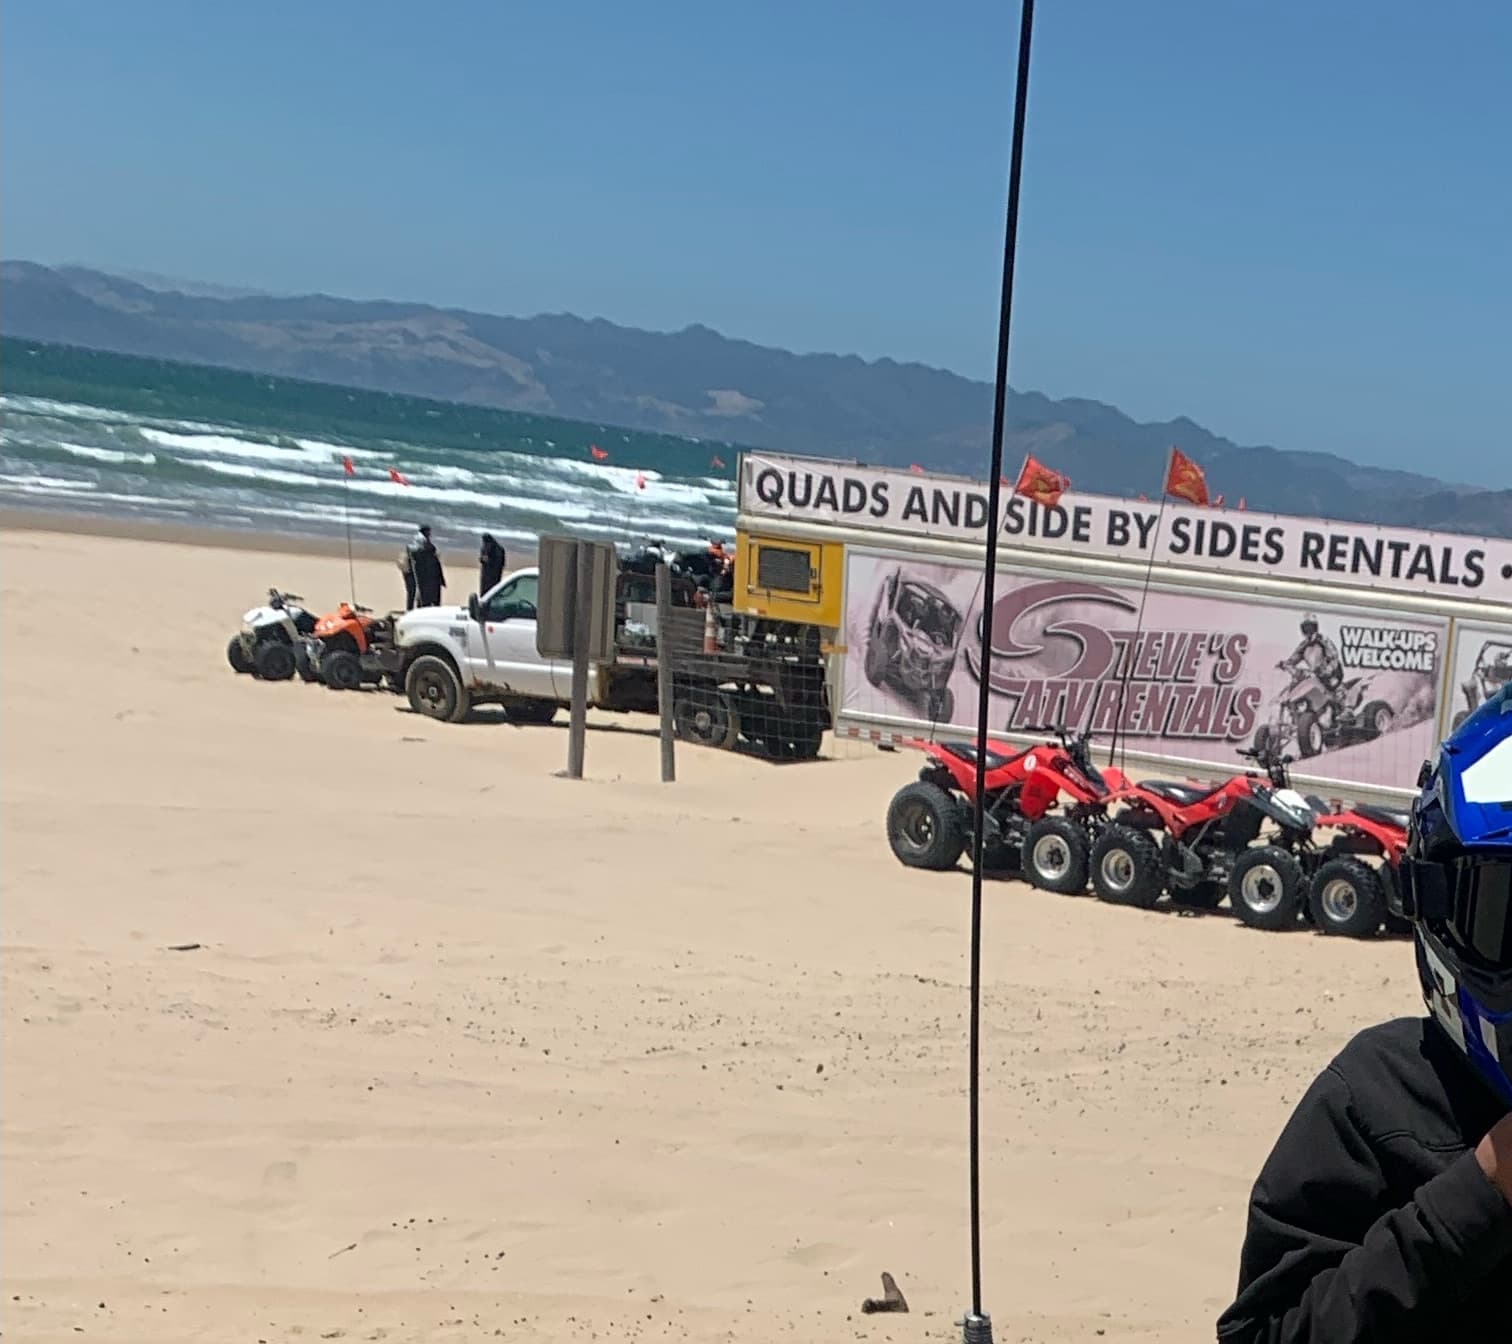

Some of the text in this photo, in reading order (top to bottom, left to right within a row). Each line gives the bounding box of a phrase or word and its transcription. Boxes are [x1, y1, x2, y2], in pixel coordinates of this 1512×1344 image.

[755, 467, 891, 518] QUADS
[901, 485, 990, 529] AND
[1003, 498, 1093, 543] SIDE
[1106, 510, 1159, 550] BY
[1168, 516, 1286, 565] SIDES
[1300, 531, 1486, 588] RENTALS
[1341, 626, 1438, 653] WALK-UPS
[1342, 646, 1435, 674] WELCOME
[1009, 680, 1262, 742] ATV RENTALS
